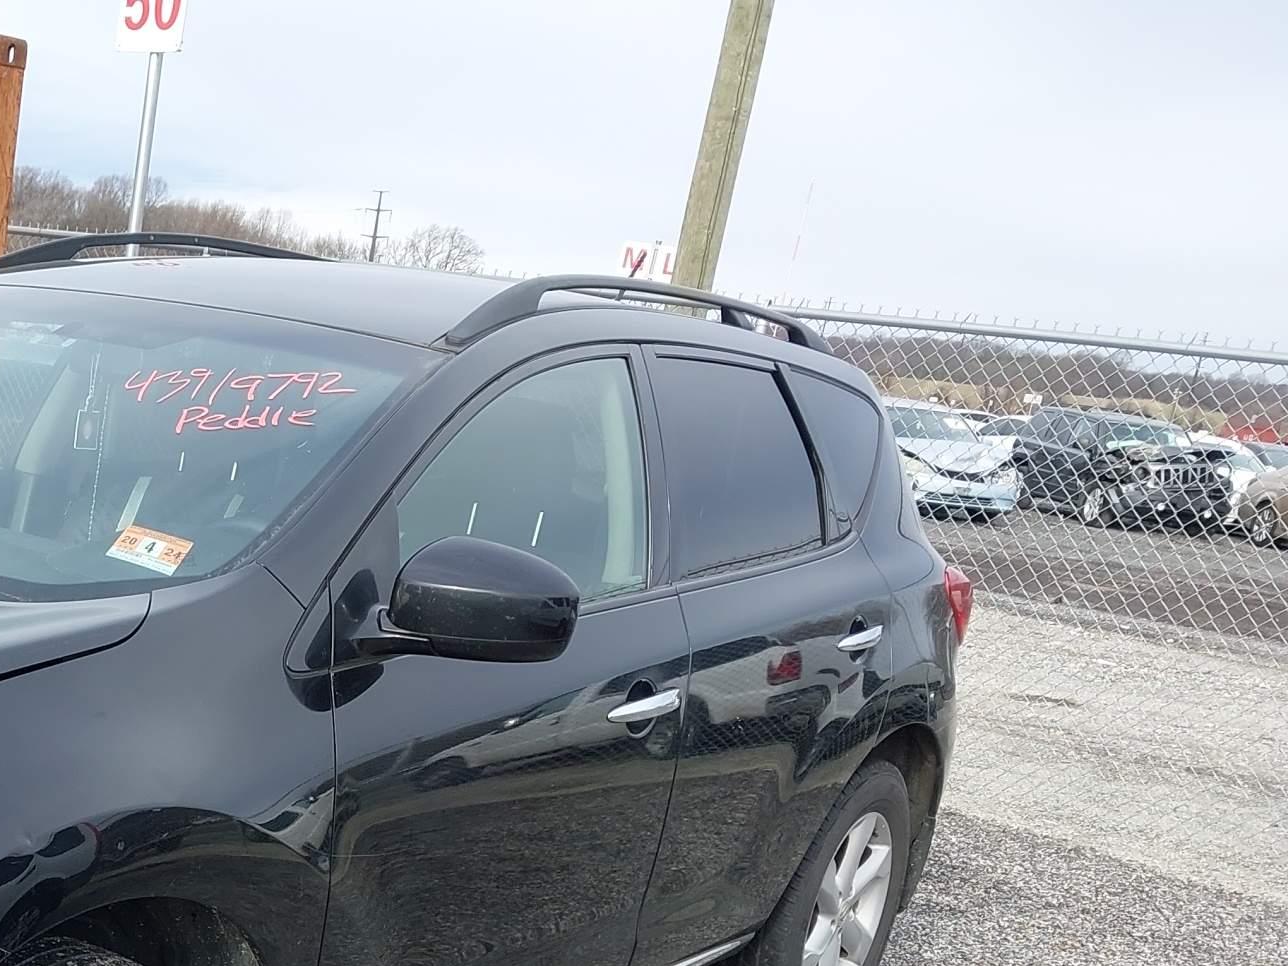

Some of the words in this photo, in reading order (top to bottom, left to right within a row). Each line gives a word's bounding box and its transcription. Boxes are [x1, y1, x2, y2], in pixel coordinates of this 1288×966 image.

[125, 0, 181, 30] 50
[121, 535, 138, 545] 20
[145, 541, 157, 553] 4
